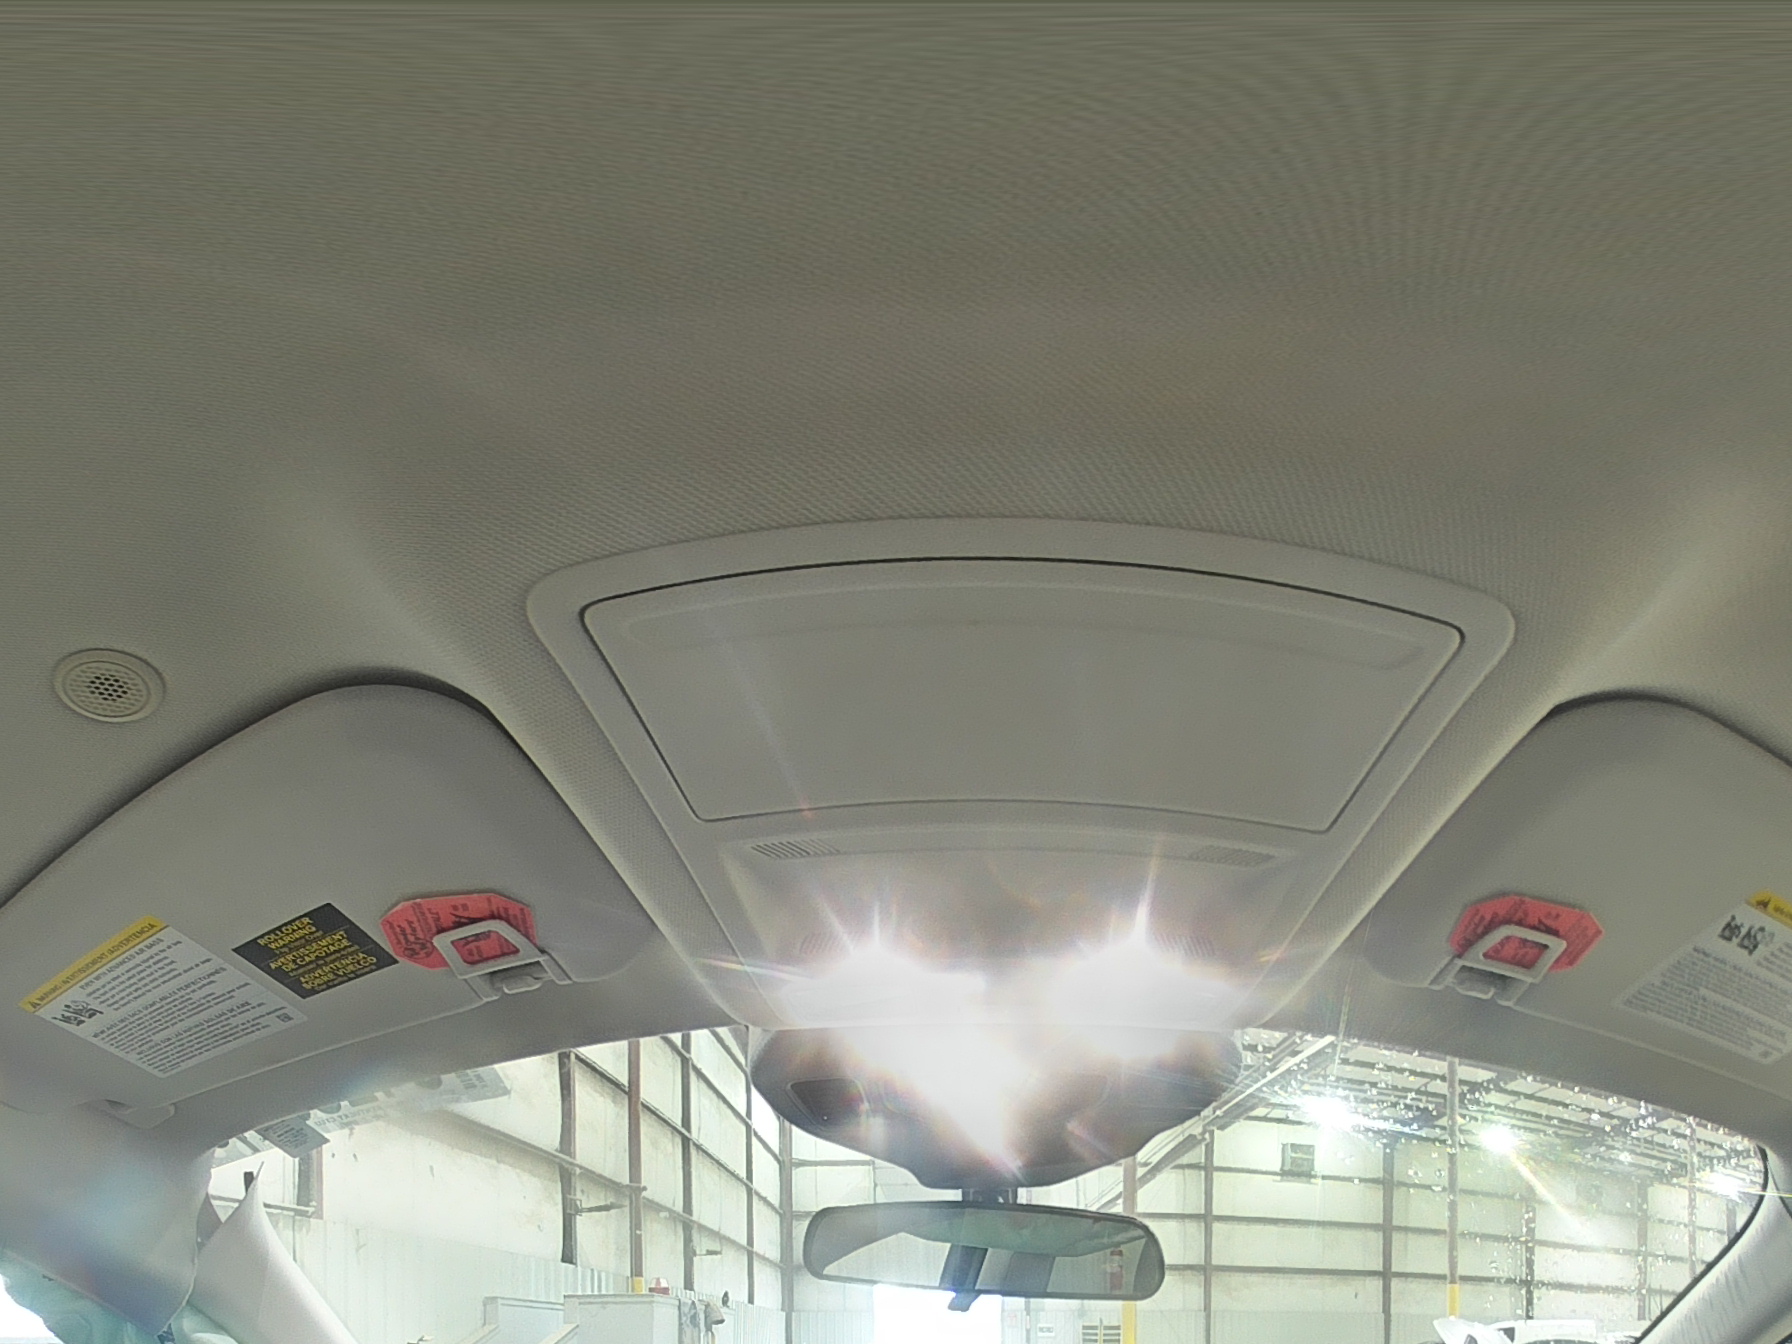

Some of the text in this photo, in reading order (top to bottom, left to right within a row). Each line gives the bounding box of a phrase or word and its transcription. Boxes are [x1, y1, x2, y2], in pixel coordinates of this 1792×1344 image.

[257, 917, 313, 946] ROLLOVER
[268, 925, 317, 949] WARNING
[269, 931, 348, 970] AVERTISSEMENT
[296, 939, 353, 965] CAPOTAGE
[299, 952, 368, 982] ADVERTENCIA
[334, 956, 377, 977] VUELCO
